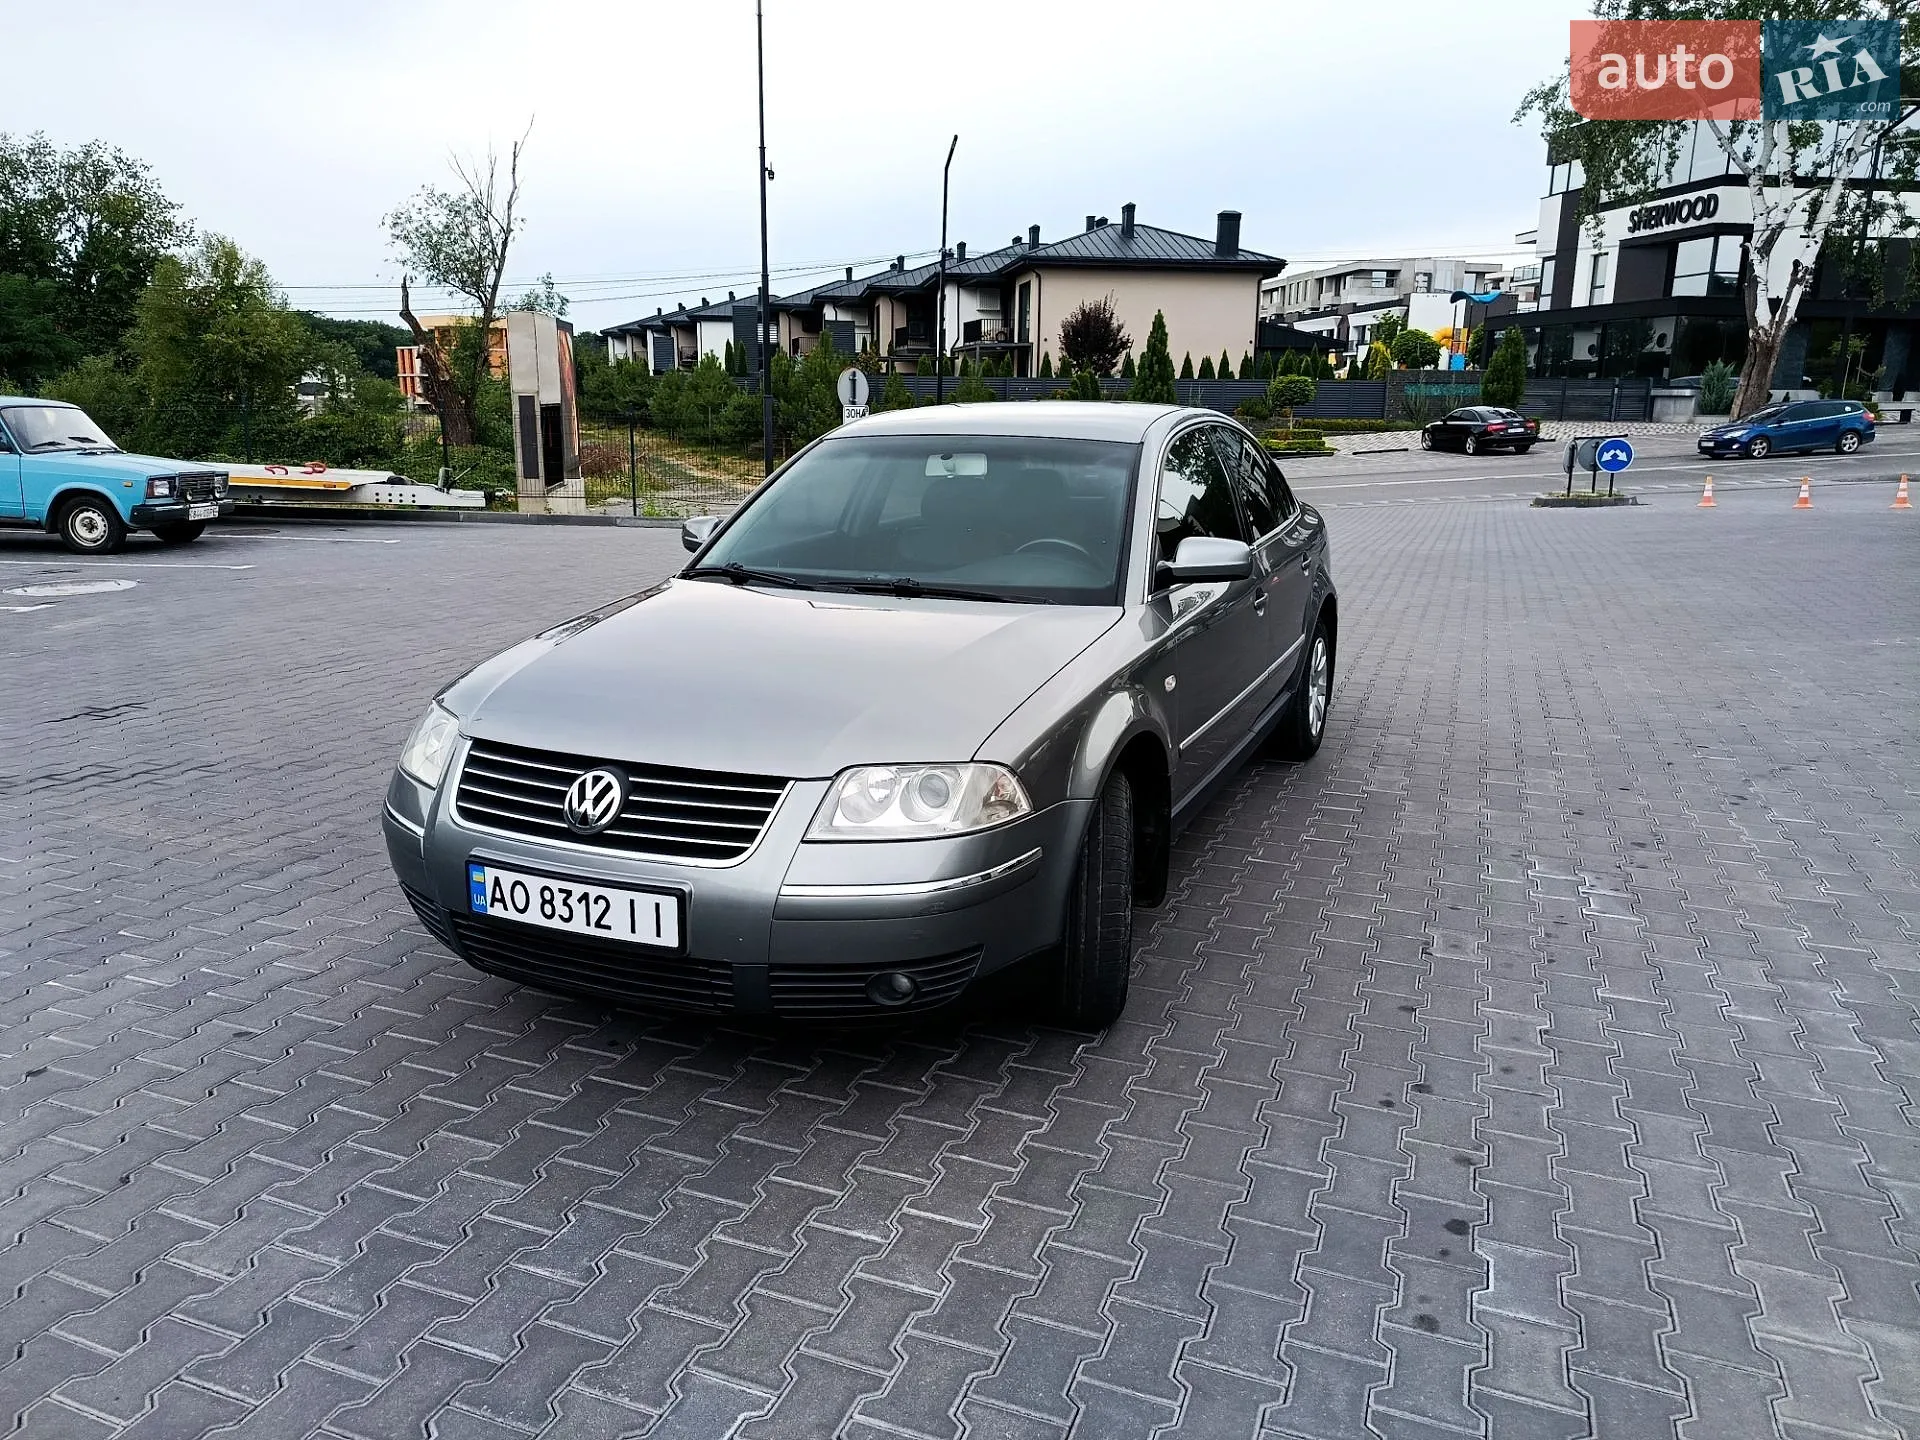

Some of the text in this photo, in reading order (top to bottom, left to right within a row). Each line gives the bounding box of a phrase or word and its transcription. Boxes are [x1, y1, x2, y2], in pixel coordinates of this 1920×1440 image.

[1627, 193, 1719, 234] SHERWOOD
[473, 894, 487, 906] UA
[489, 875, 530, 915] AO
[539, 885, 612, 931] 8312
